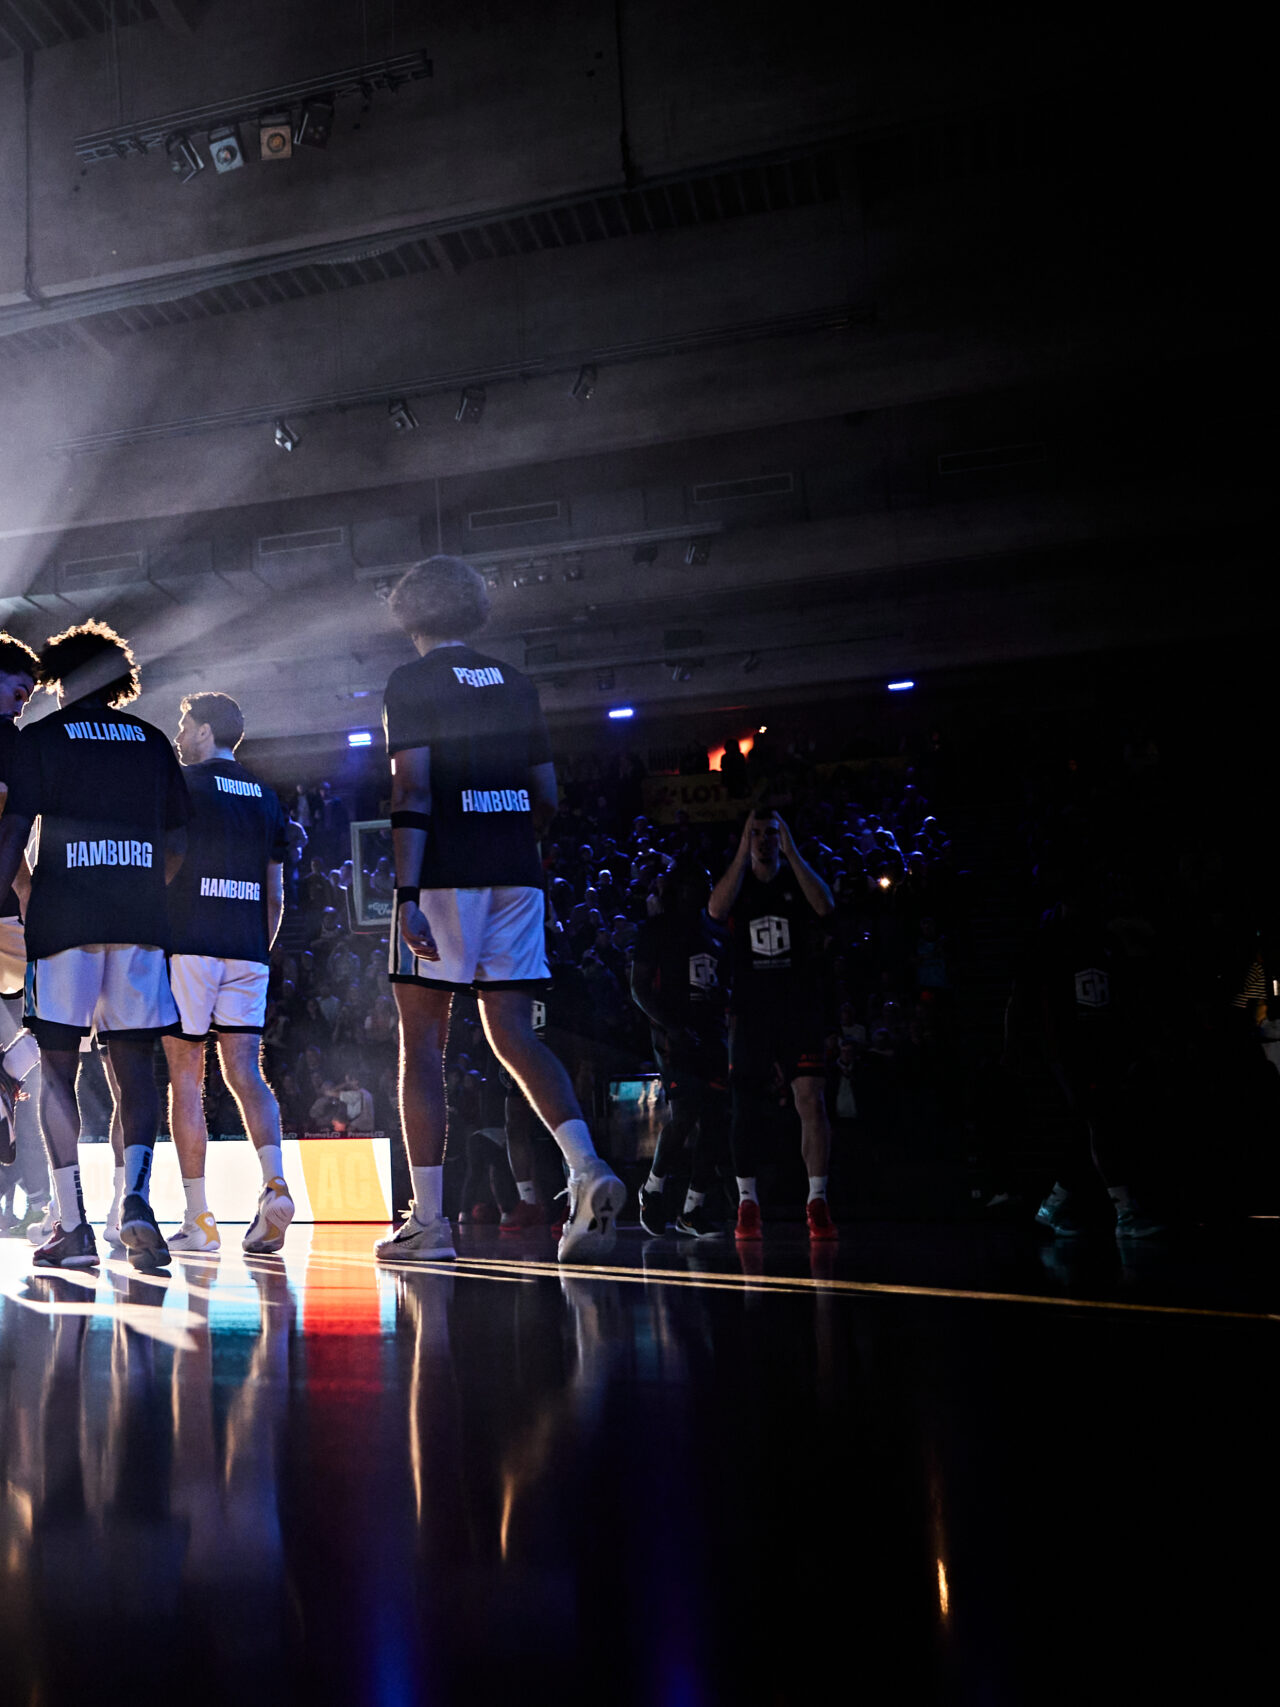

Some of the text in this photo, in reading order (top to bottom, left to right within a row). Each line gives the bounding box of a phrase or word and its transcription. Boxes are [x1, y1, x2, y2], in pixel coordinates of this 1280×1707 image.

[64, 721, 147, 742] WILLIAMS
[461, 789, 532, 814] HAMBURG
[66, 839, 153, 869] HAMBURG
[200, 877, 261, 901] HAMBURG
